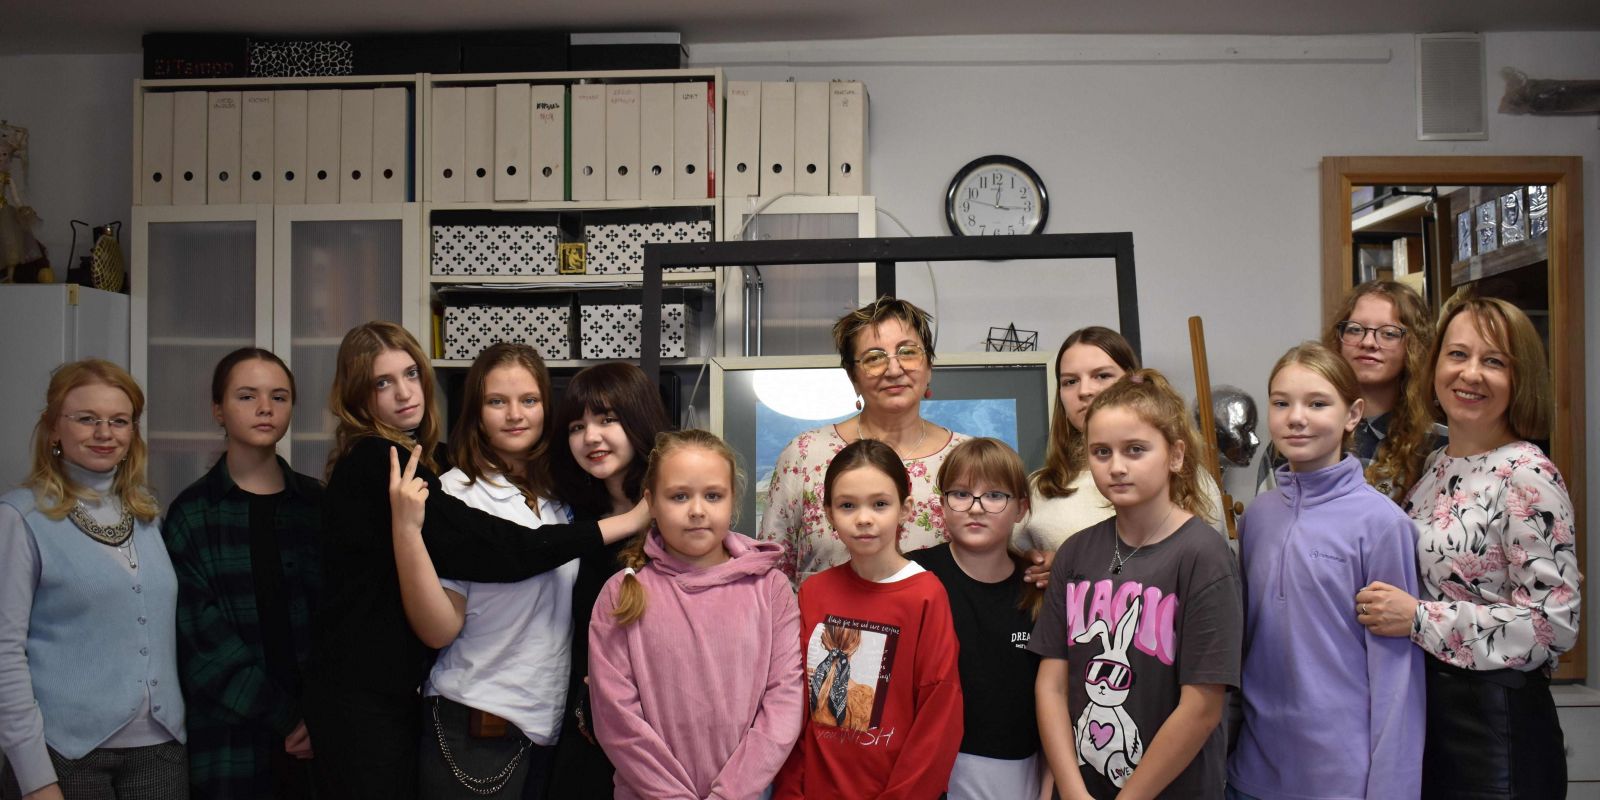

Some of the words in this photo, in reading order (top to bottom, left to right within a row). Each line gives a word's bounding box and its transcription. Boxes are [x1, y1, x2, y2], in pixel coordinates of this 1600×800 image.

[979, 176, 988, 189] 11
[992, 172, 1003, 185] 12
[1010, 177, 1015, 189] 1
[968, 187, 979, 200] 10
[1019, 187, 1028, 199] 2
[962, 202, 970, 213] 9
[1023, 201, 1032, 213] 3
[968, 215, 976, 226] 8
[1018, 215, 1026, 226] 4
[979, 225, 987, 236] 7
[993, 228, 1001, 236] 6
[1007, 225, 1015, 236] 5
[1011, 631, 1031, 643] DREA
[1110, 766, 1132, 780] LOVE
